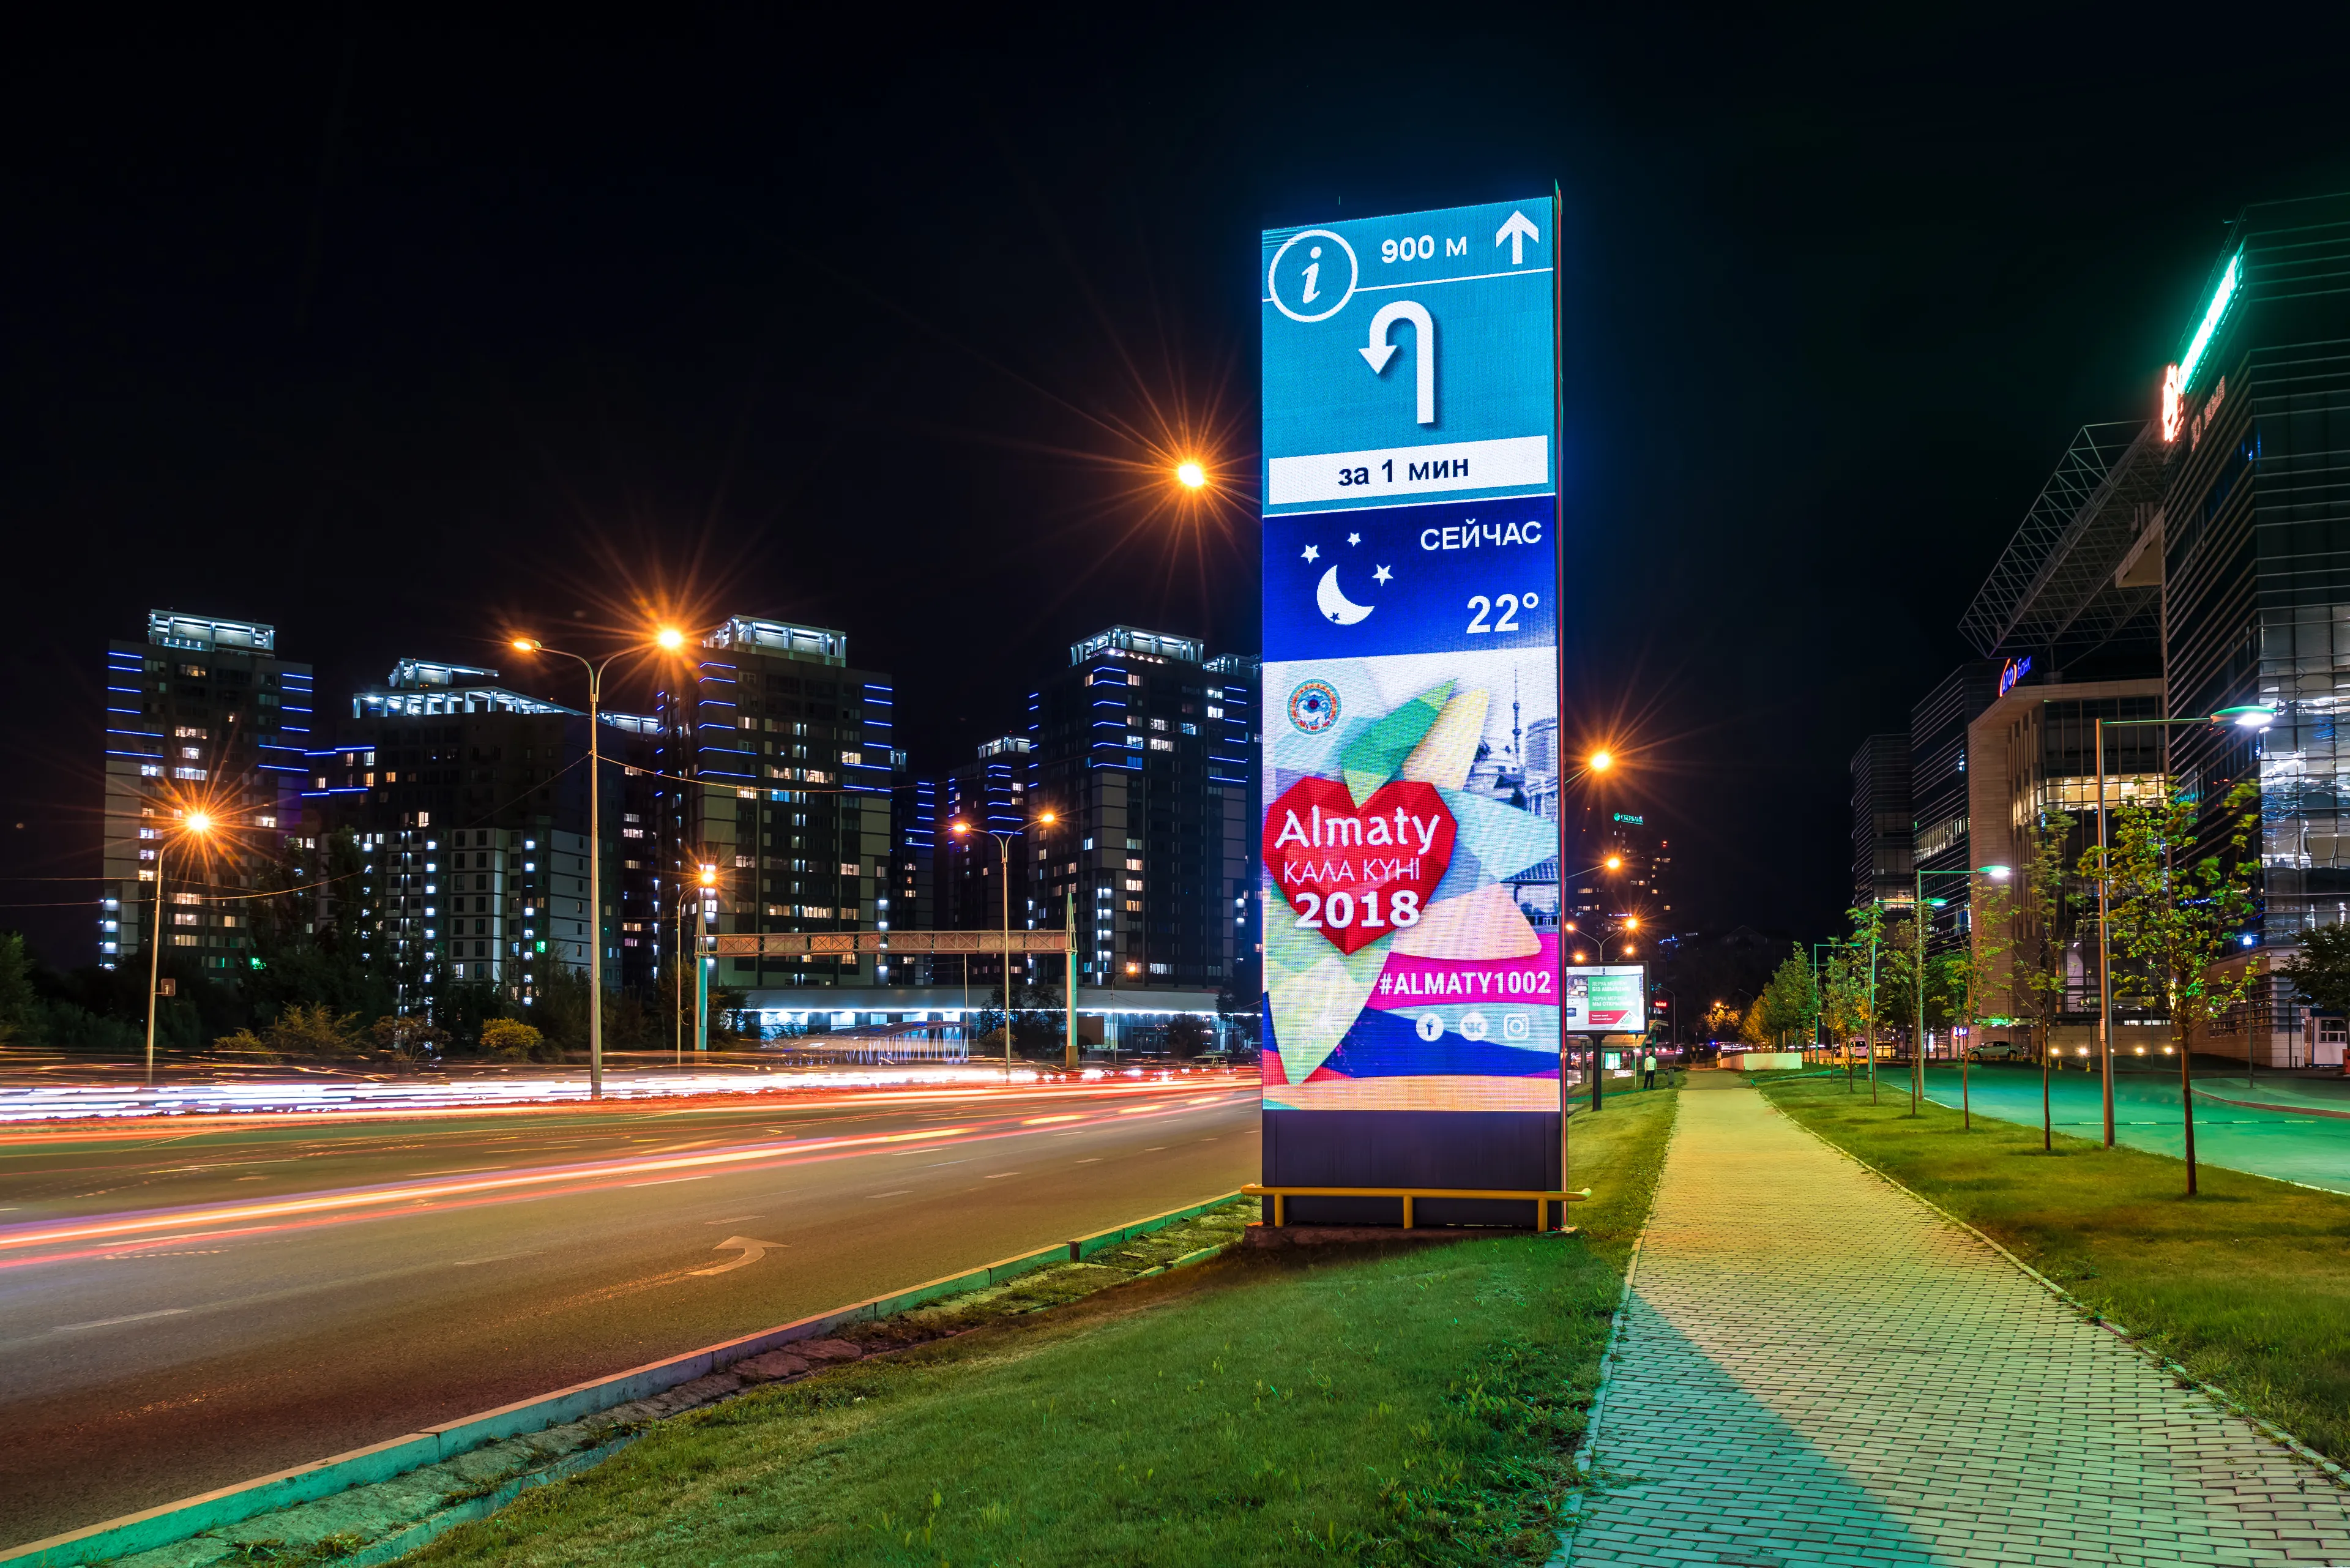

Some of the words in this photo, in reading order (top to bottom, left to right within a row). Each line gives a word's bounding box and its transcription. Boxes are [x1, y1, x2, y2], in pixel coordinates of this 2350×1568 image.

[1381, 234, 1434, 264] 900
[1338, 467, 1370, 487] за
[1381, 459, 1394, 483] 1
[1408, 458, 1469, 482] мин
[1420, 518, 1542, 551] СЕЙЧАС
[1466, 592, 1539, 634] 22°
[1275, 804, 1441, 854] Almaty
[1294, 890, 1420, 929] 2018
[1379, 971, 1552, 996] #ALMATY1002
